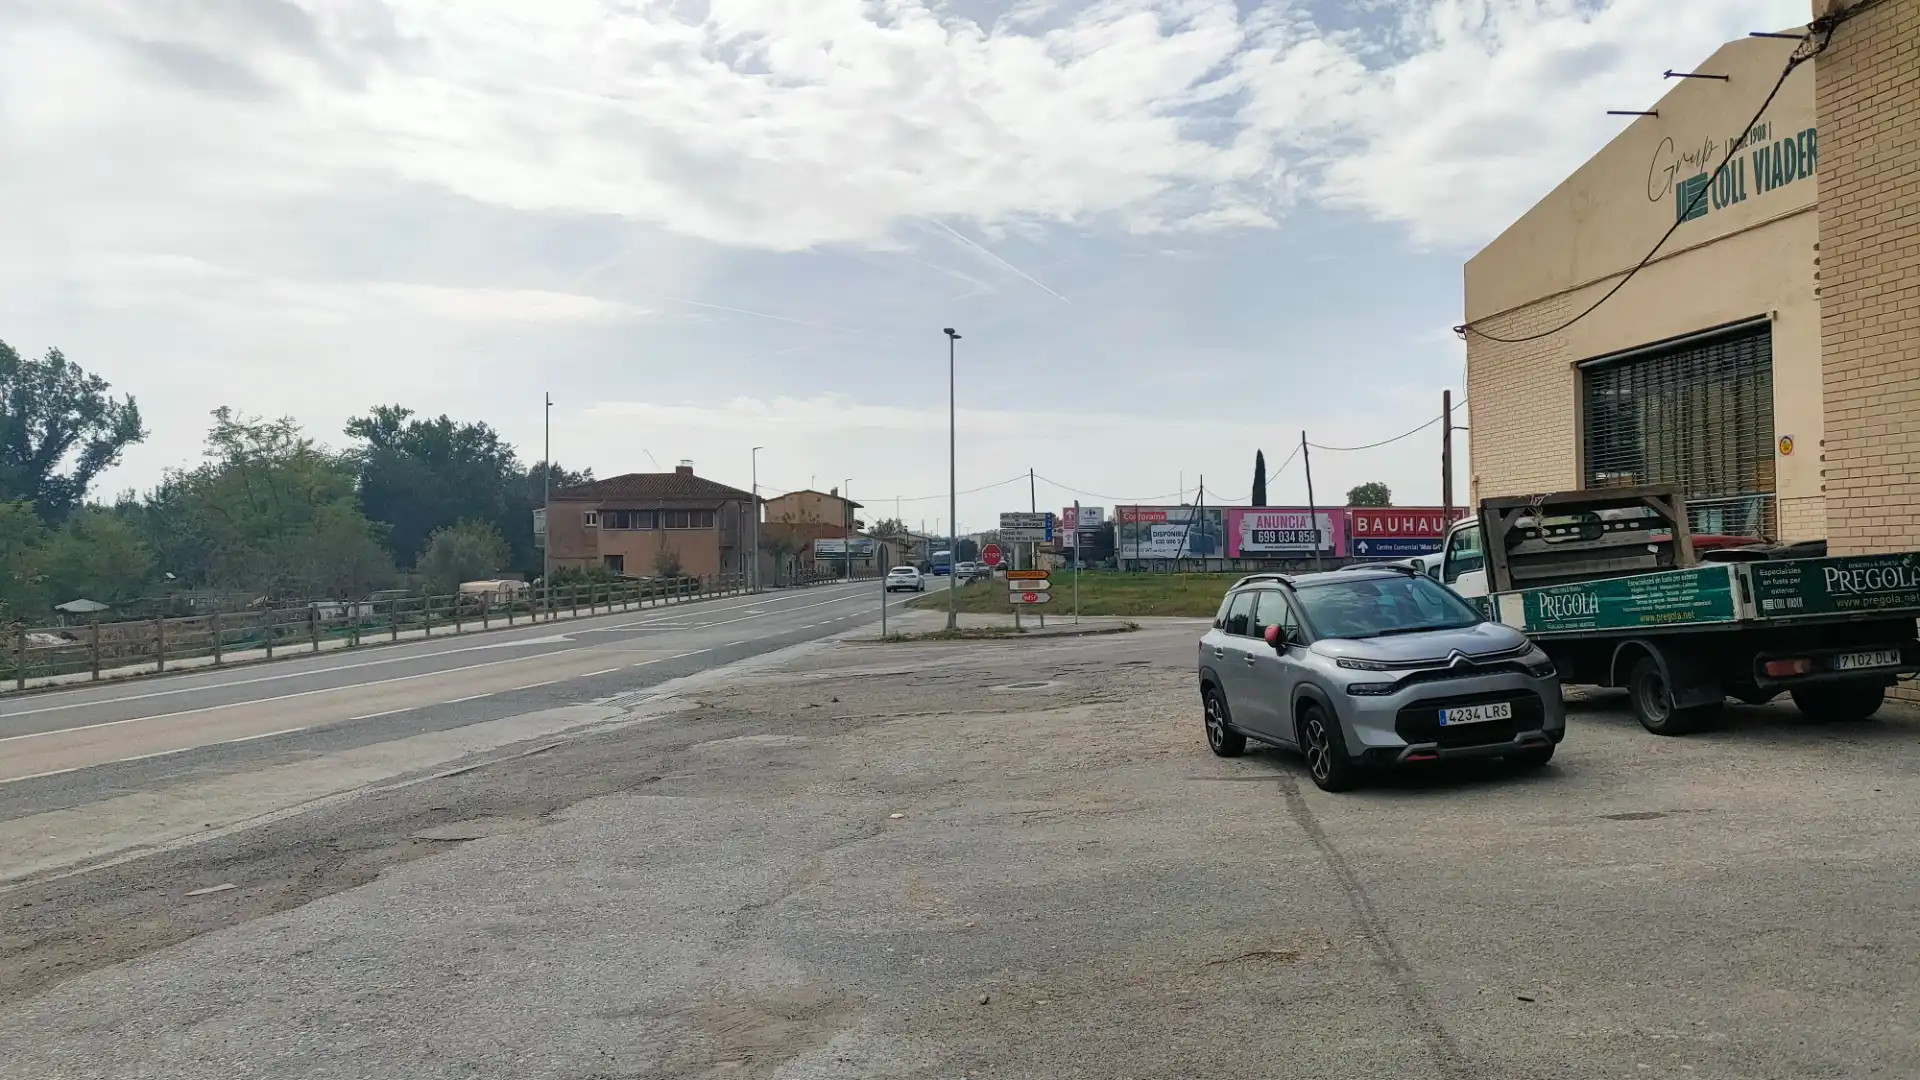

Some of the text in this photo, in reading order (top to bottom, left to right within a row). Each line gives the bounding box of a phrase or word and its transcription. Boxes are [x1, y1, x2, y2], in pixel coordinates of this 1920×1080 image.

[1750, 123, 1766, 146] 1908
[1712, 128, 1817, 210] COLL VIADER
[1357, 517, 1444, 532] BAUHAU
[1258, 531, 1315, 543] 699 034 858
[1393, 543, 1419, 551] Comercial
[1759, 568, 1802, 577] Especialistes
[1789, 576, 1801, 585] per
[1822, 566, 1920, 594] PREGOLA
[1538, 592, 1600, 620] PREGOLA
[1640, 610, 1696, 623] www.pregola.net
[1842, 651, 1899, 668] 7102 DLM
[1449, 704, 1508, 722] 4234 LRS
